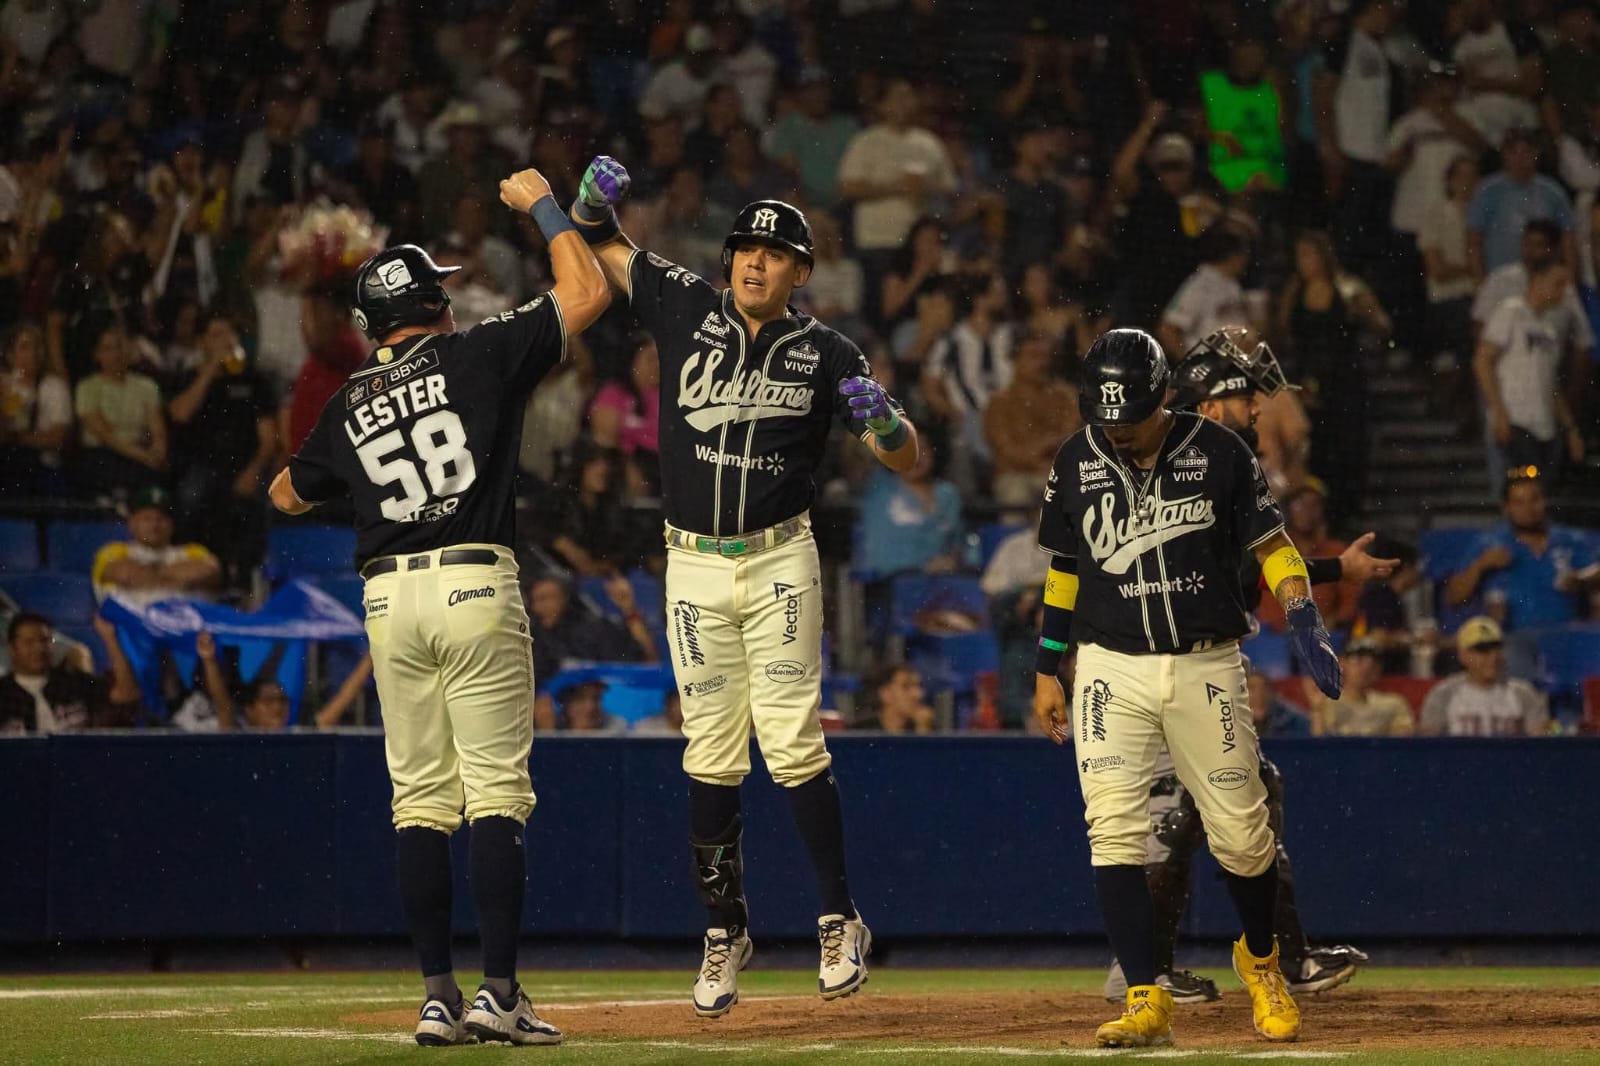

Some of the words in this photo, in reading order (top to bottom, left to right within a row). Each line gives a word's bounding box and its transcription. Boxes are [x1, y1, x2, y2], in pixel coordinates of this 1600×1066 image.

[390, 356, 430, 382] BBVA
[678, 349, 815, 411] Sultanes
[344, 373, 450, 447] LESTER
[1104, 408, 1120, 420] 19
[356, 409, 477, 522] 58
[695, 444, 765, 470] Walmart
[1079, 459, 1105, 471] Mobil
[1175, 458, 1207, 467] mission
[1080, 469, 1107, 481] Super
[1086, 480, 1116, 491] VIDUSA
[1082, 492, 1214, 562] Sultanes
[448, 585, 496, 607] Clamato
[1118, 577, 1183, 599] Walmart
[782, 593, 798, 646] Vector
[1219, 698, 1236, 753] Vector
